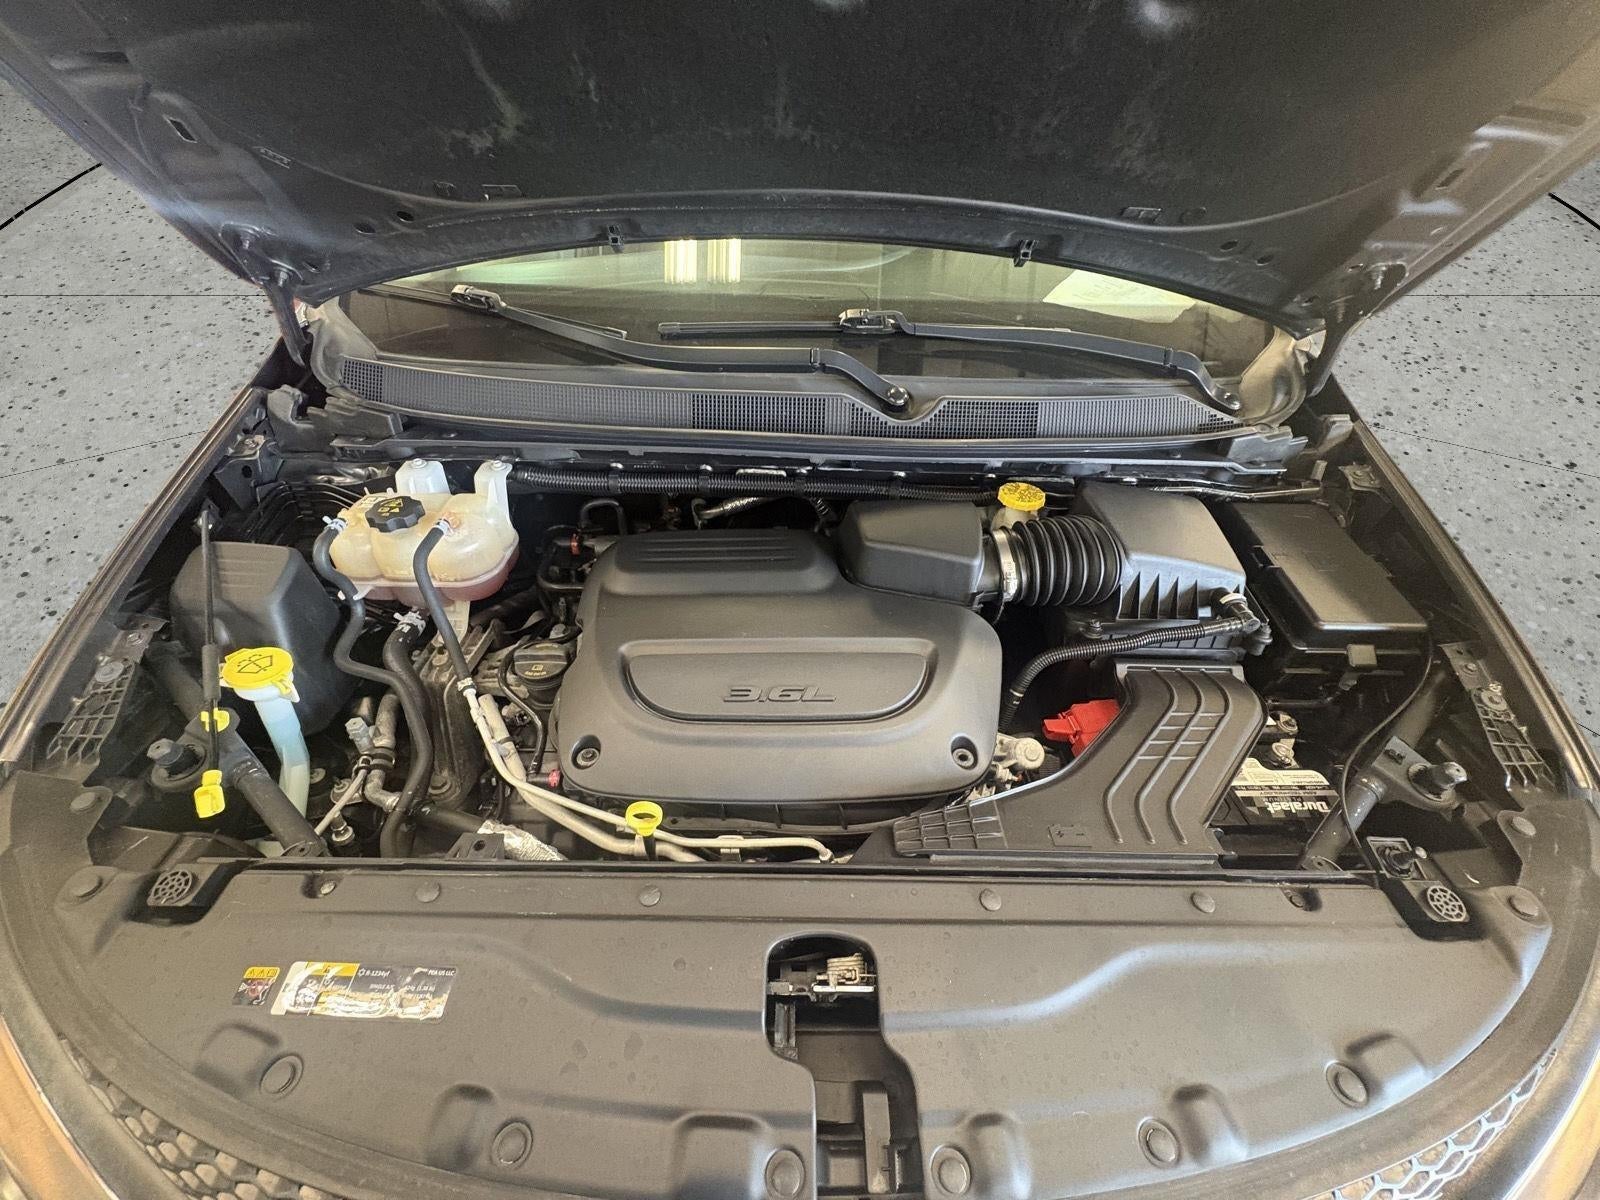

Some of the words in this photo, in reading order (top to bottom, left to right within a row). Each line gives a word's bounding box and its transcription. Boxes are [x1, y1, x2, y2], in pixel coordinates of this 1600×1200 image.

[723, 686, 837, 703] 3.6L
[1264, 801, 1331, 814] Duralast
[364, 970, 391, 978] R-1234yf
